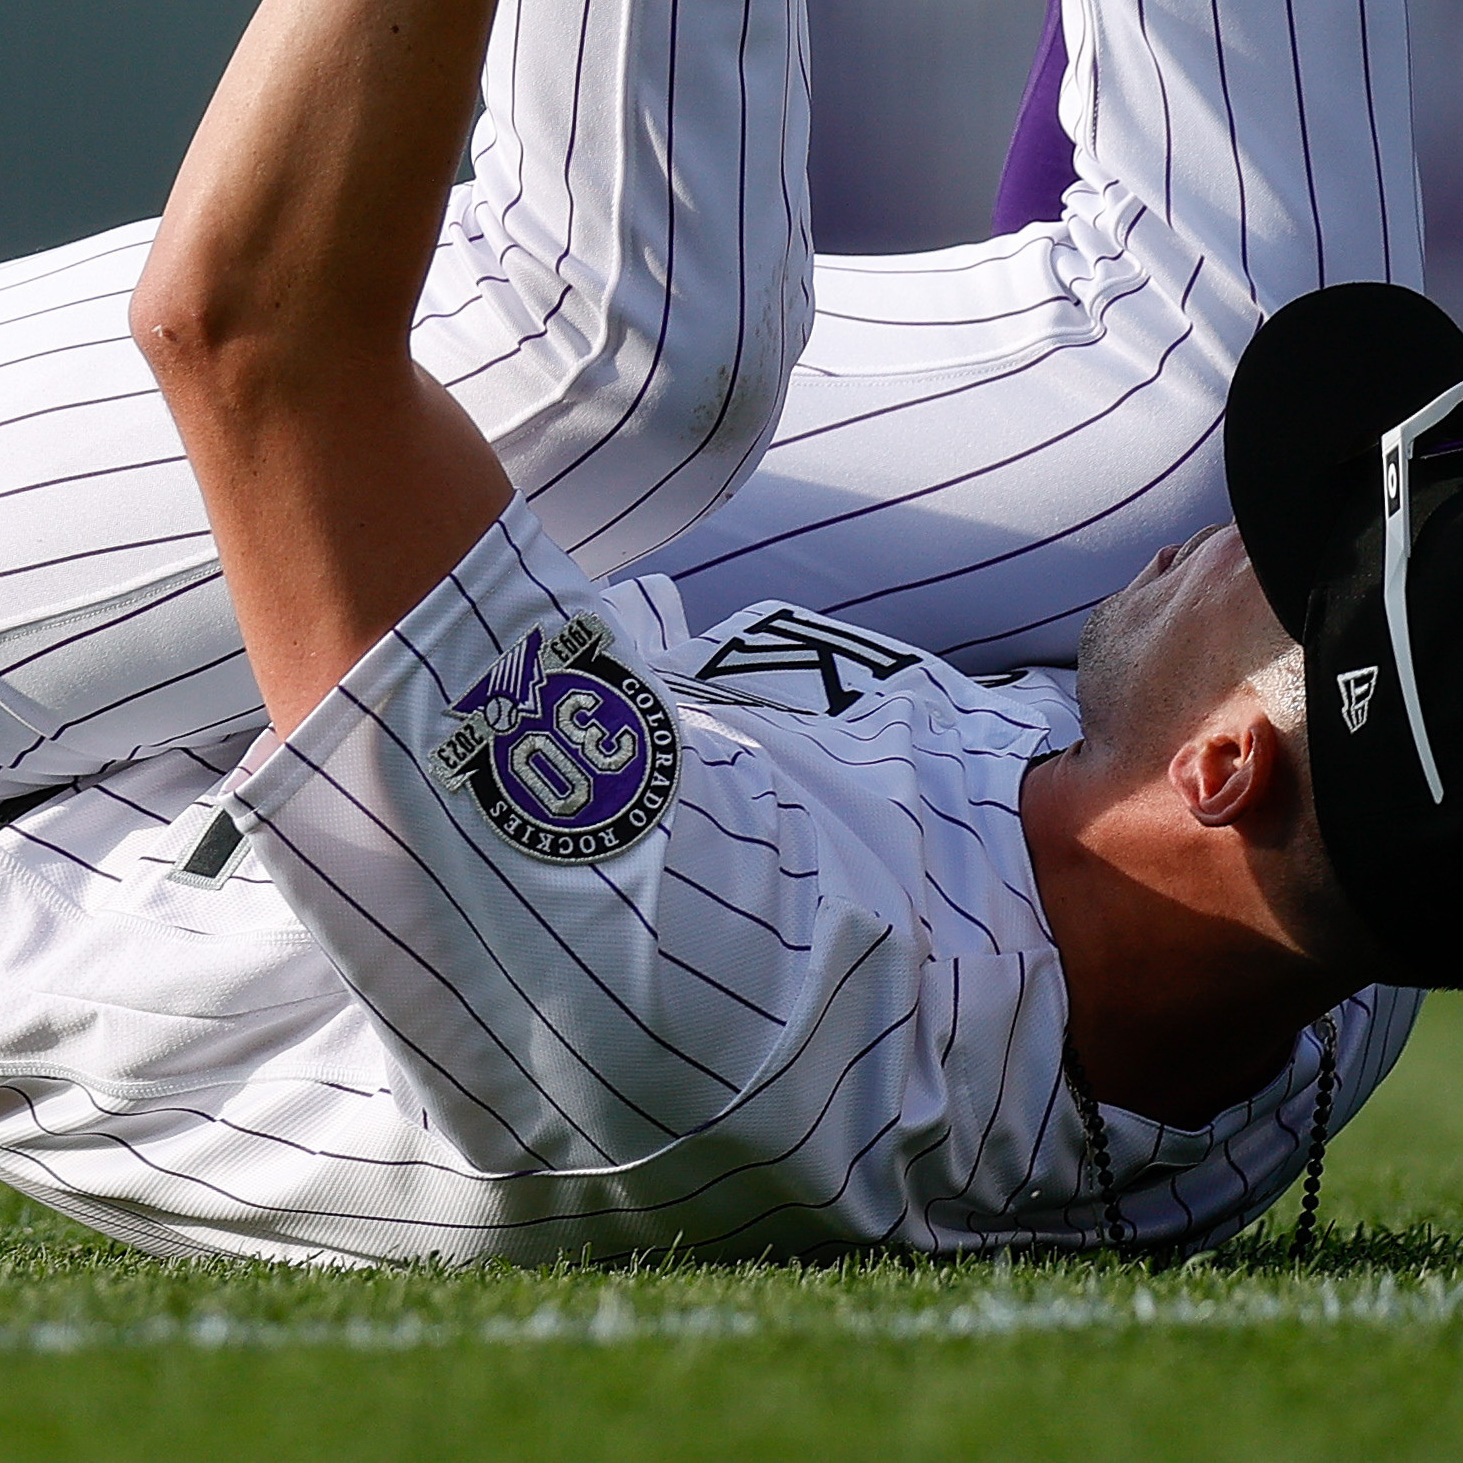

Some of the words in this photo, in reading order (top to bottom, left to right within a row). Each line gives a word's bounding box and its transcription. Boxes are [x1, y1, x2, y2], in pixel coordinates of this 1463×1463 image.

[549, 619, 594, 661] 1993
[437, 722, 485, 770] 2023
[508, 688, 639, 820] 30
[621, 677, 675, 827] COLORADO
[488, 799, 621, 856] ROCKIES
